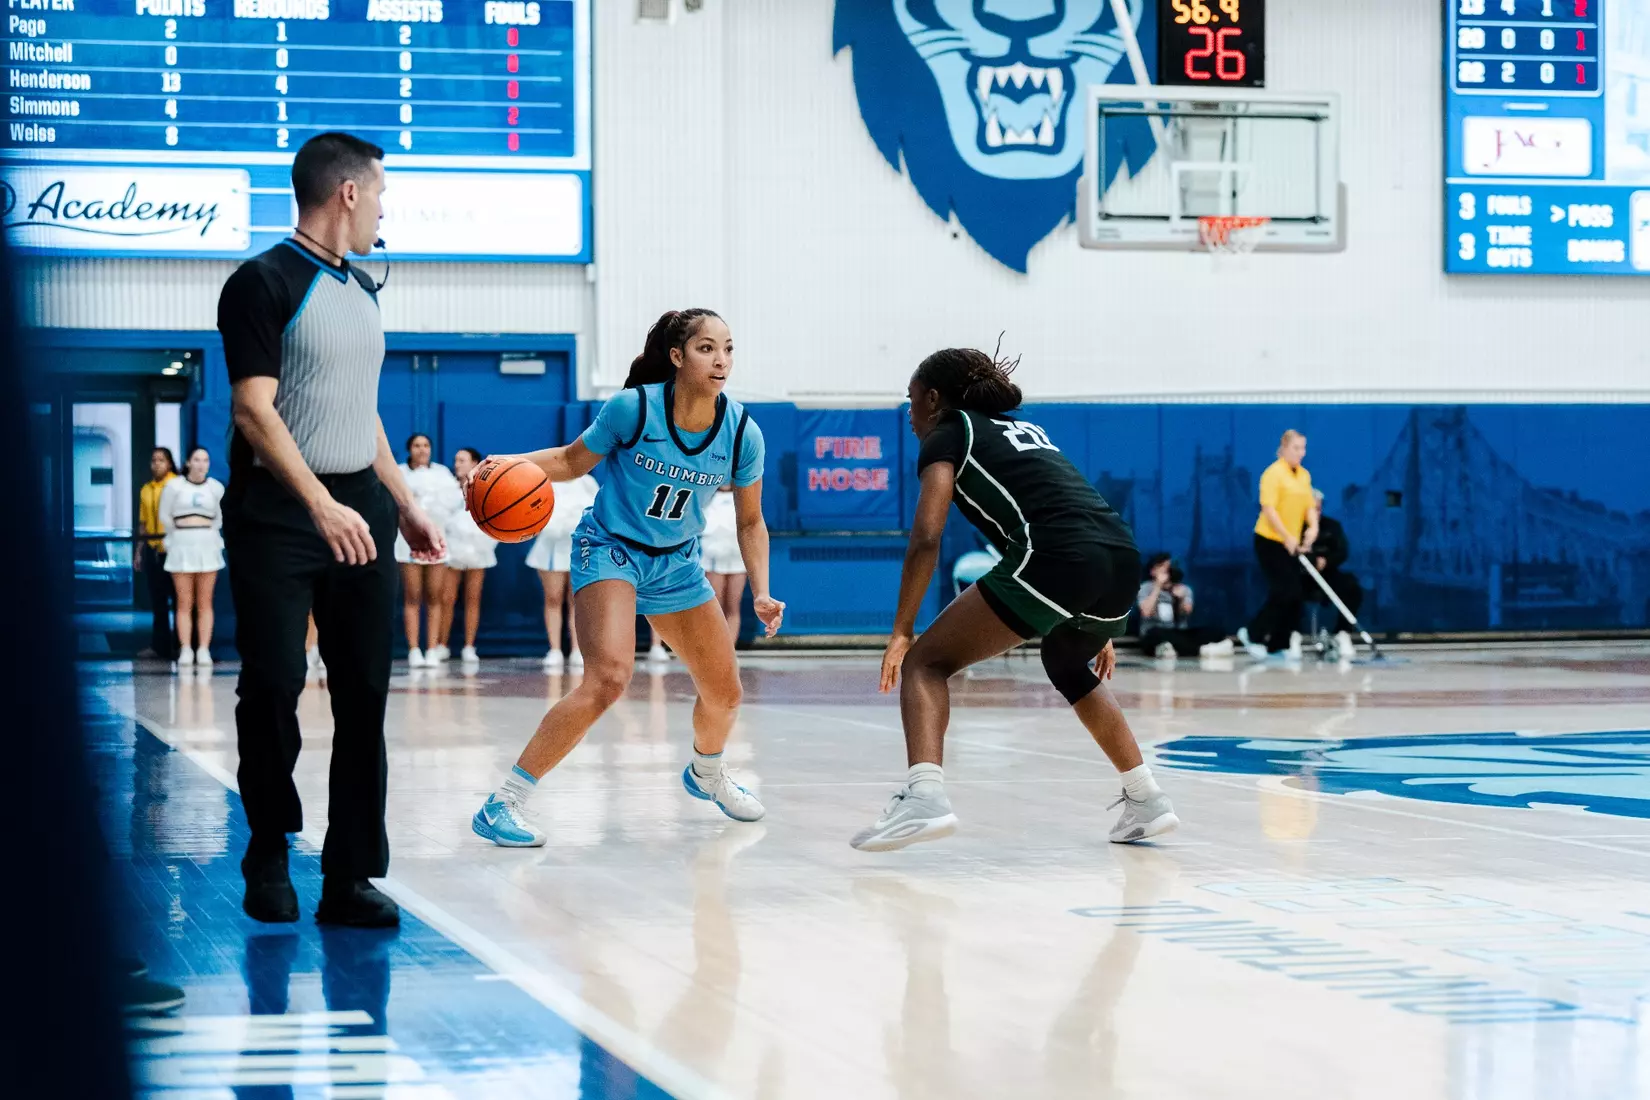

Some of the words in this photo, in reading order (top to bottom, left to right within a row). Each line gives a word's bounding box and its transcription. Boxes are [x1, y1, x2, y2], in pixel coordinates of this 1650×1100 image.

[136, 0, 205, 17] POINTS
[234, 0, 329, 20] REBOUNDS
[366, 0, 443, 23] ASSISTS
[485, 1, 540, 25] FOULS
[9, 15, 46, 37] Page
[165, 19, 177, 39] 2
[276, 21, 288, 42] 1
[399, 24, 412, 45] 2
[1501, 28, 1516, 49] 0
[1576, 30, 1586, 50] 1
[10, 42, 73, 63] Mitchell
[165, 45, 178, 65] 0
[276, 48, 289, 68] 0
[1184, 26, 1246, 80] 26
[10, 69, 91, 90] Henderson
[161, 72, 181, 92] 13
[275, 75, 288, 95] 4
[400, 78, 412, 98] 2
[1501, 61, 1516, 83] 2
[1540, 62, 1555, 84] 0
[1576, 64, 1586, 84] 1
[10, 96, 80, 116] Simmons
[165, 99, 178, 119] 4
[277, 101, 288, 122] 1
[508, 106, 519, 125] 2
[10, 123, 56, 143] Weiss
[277, 128, 289, 148] 2
[399, 130, 412, 150] 4
[28, 181, 220, 236] Academy
[1459, 192, 1476, 220] 3
[1486, 194, 1533, 215] FOULS
[1567, 204, 1614, 228] POSS
[1458, 232, 1476, 260] 3
[1486, 225, 1533, 246] TIME
[1486, 247, 1533, 268] OUTS
[815, 436, 882, 459] FIRE
[990, 418, 1060, 452] 20
[634, 452, 724, 486] COLUMBIA
[808, 468, 889, 491] HOSE
[645, 483, 694, 521] 11
